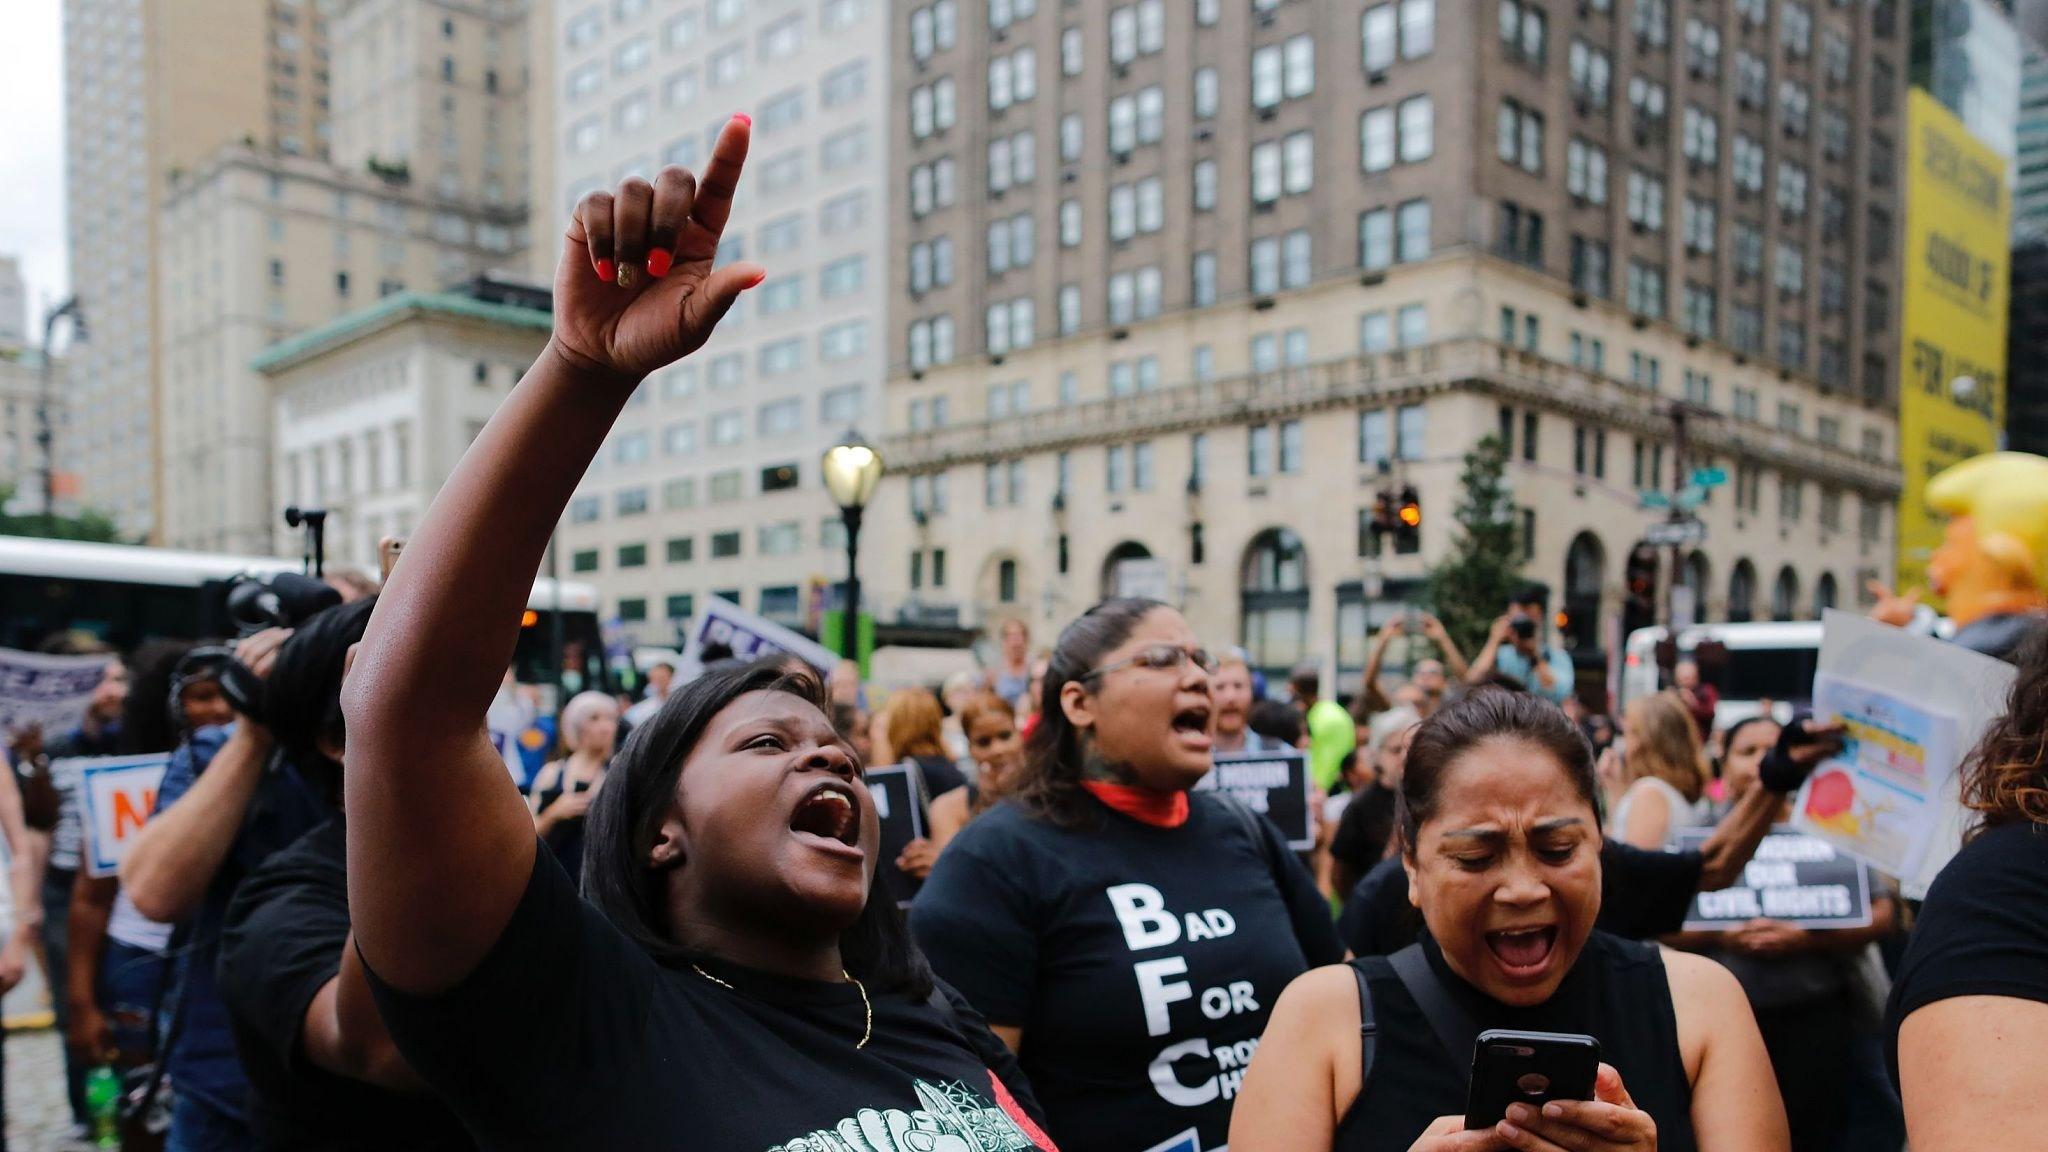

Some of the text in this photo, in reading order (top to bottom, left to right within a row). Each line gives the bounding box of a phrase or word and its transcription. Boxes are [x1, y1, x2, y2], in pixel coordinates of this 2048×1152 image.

[1106, 882, 1237, 951] BAD
[1761, 884, 1851, 917] RIGHTS
[1133, 955, 1260, 1037] FOR
